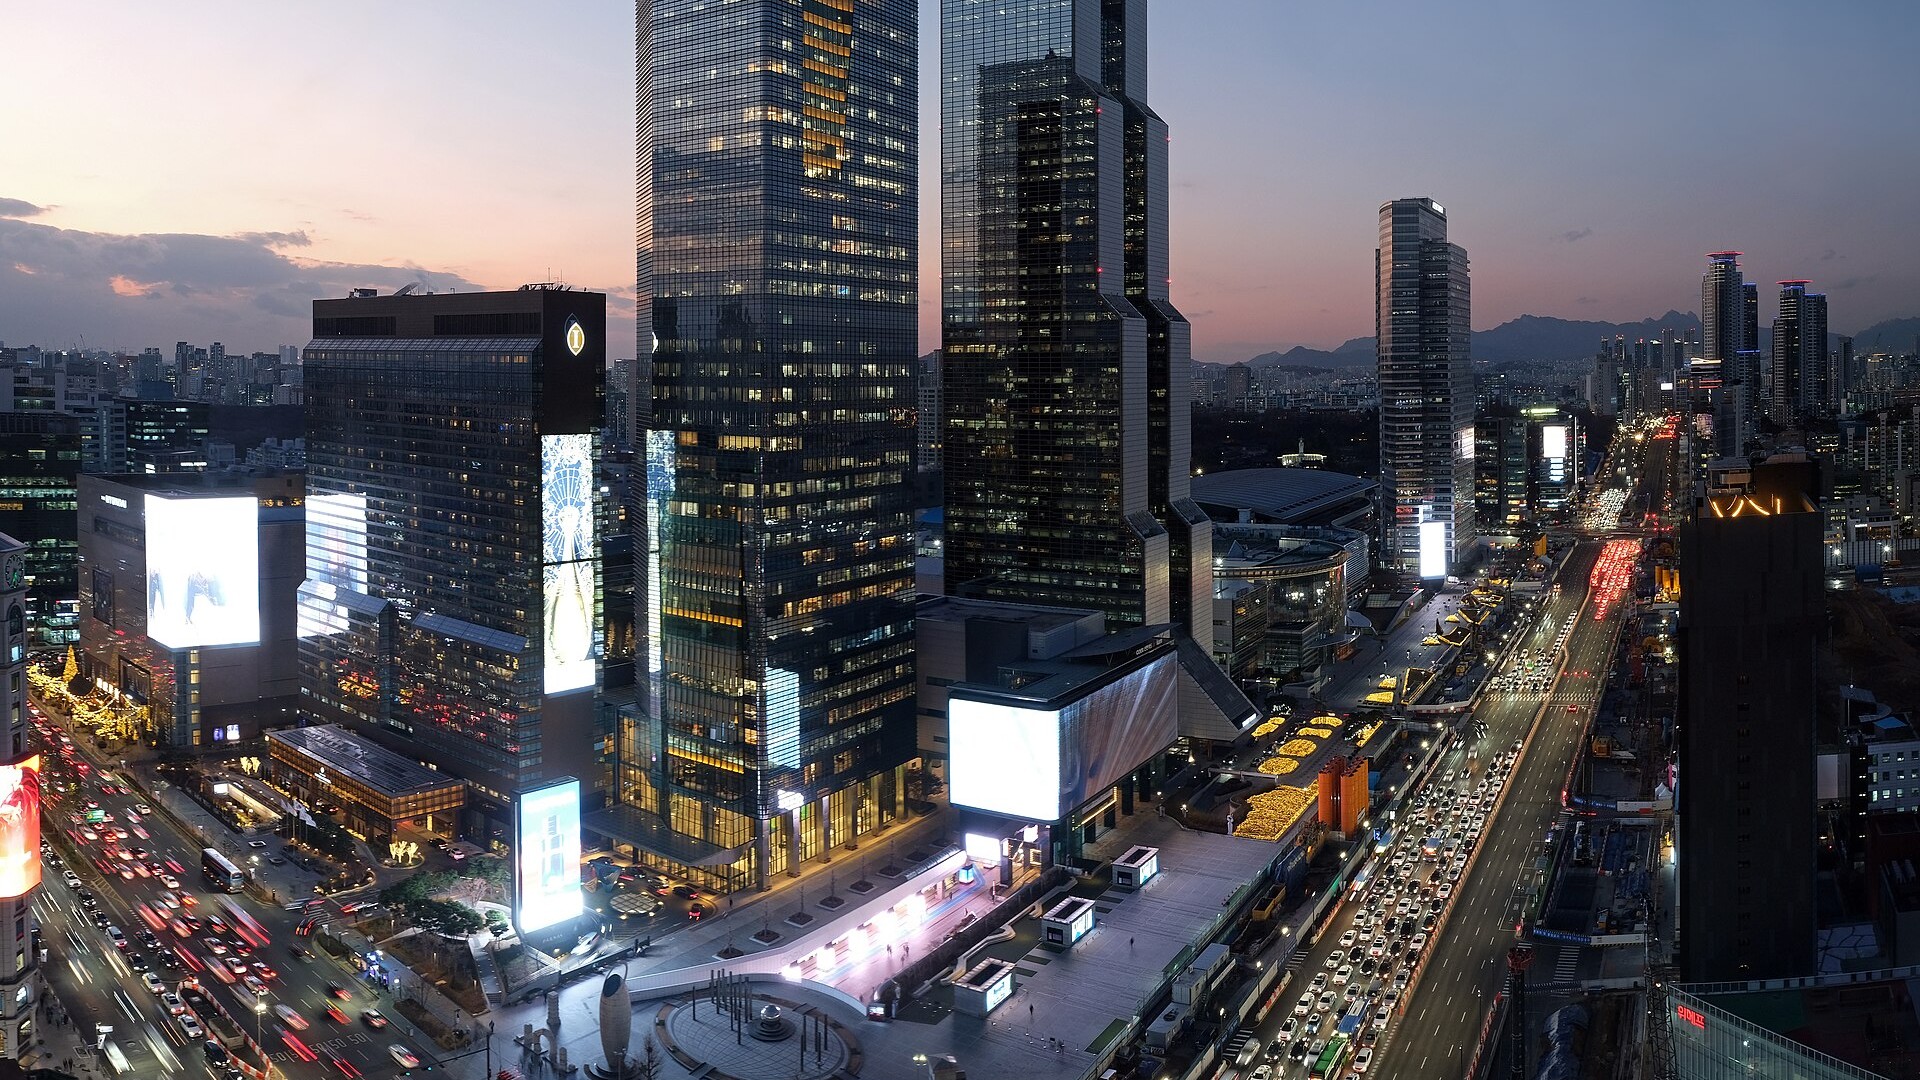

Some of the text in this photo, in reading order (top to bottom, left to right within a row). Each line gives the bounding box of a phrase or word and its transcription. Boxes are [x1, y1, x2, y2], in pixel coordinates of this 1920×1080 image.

[1677, 1005, 1705, 1029] 위메프
[327, 1038, 347, 1050] 50
[346, 1033, 367, 1045] 50
[270, 1052, 287, 1063] 50
